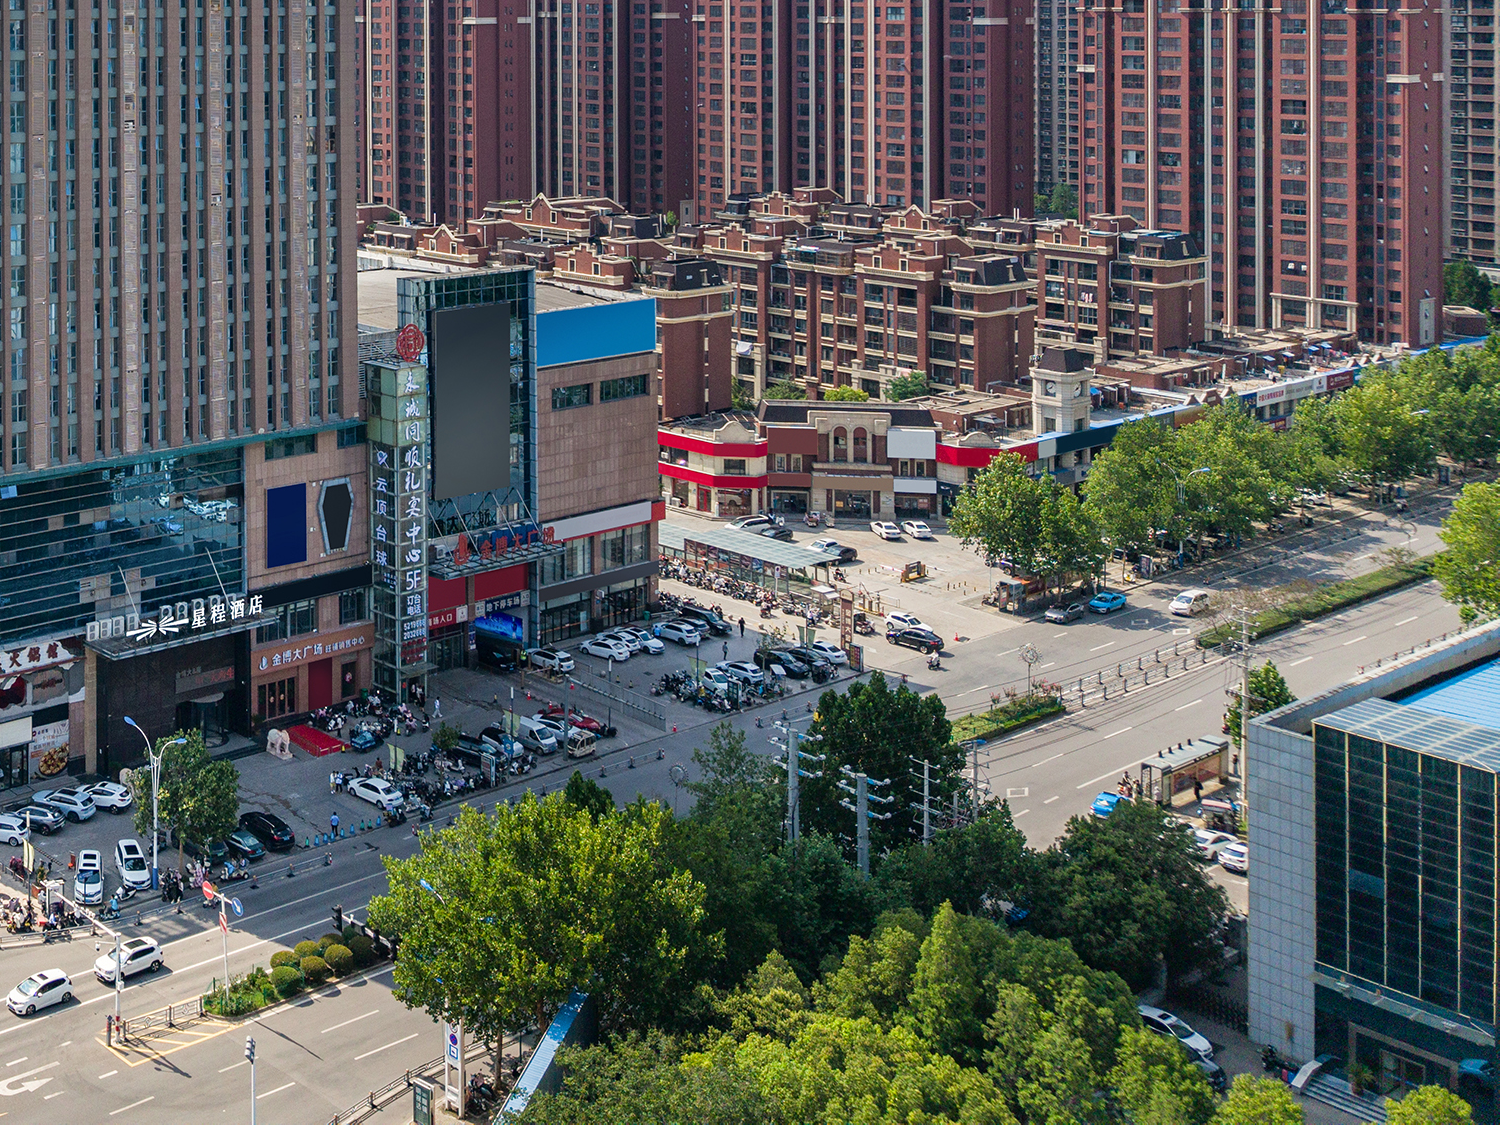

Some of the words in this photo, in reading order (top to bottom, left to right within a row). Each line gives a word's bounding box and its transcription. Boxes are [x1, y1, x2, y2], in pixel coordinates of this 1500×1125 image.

[375, 477, 388, 567] 云顶台球
[481, 526, 555, 560] 金博大广场
[406, 569, 422, 591] 5F
[191, 594, 263, 629] 星程酒店
[486, 596, 520, 612] 地下停车场
[272, 643, 323, 667] 金博大广场
